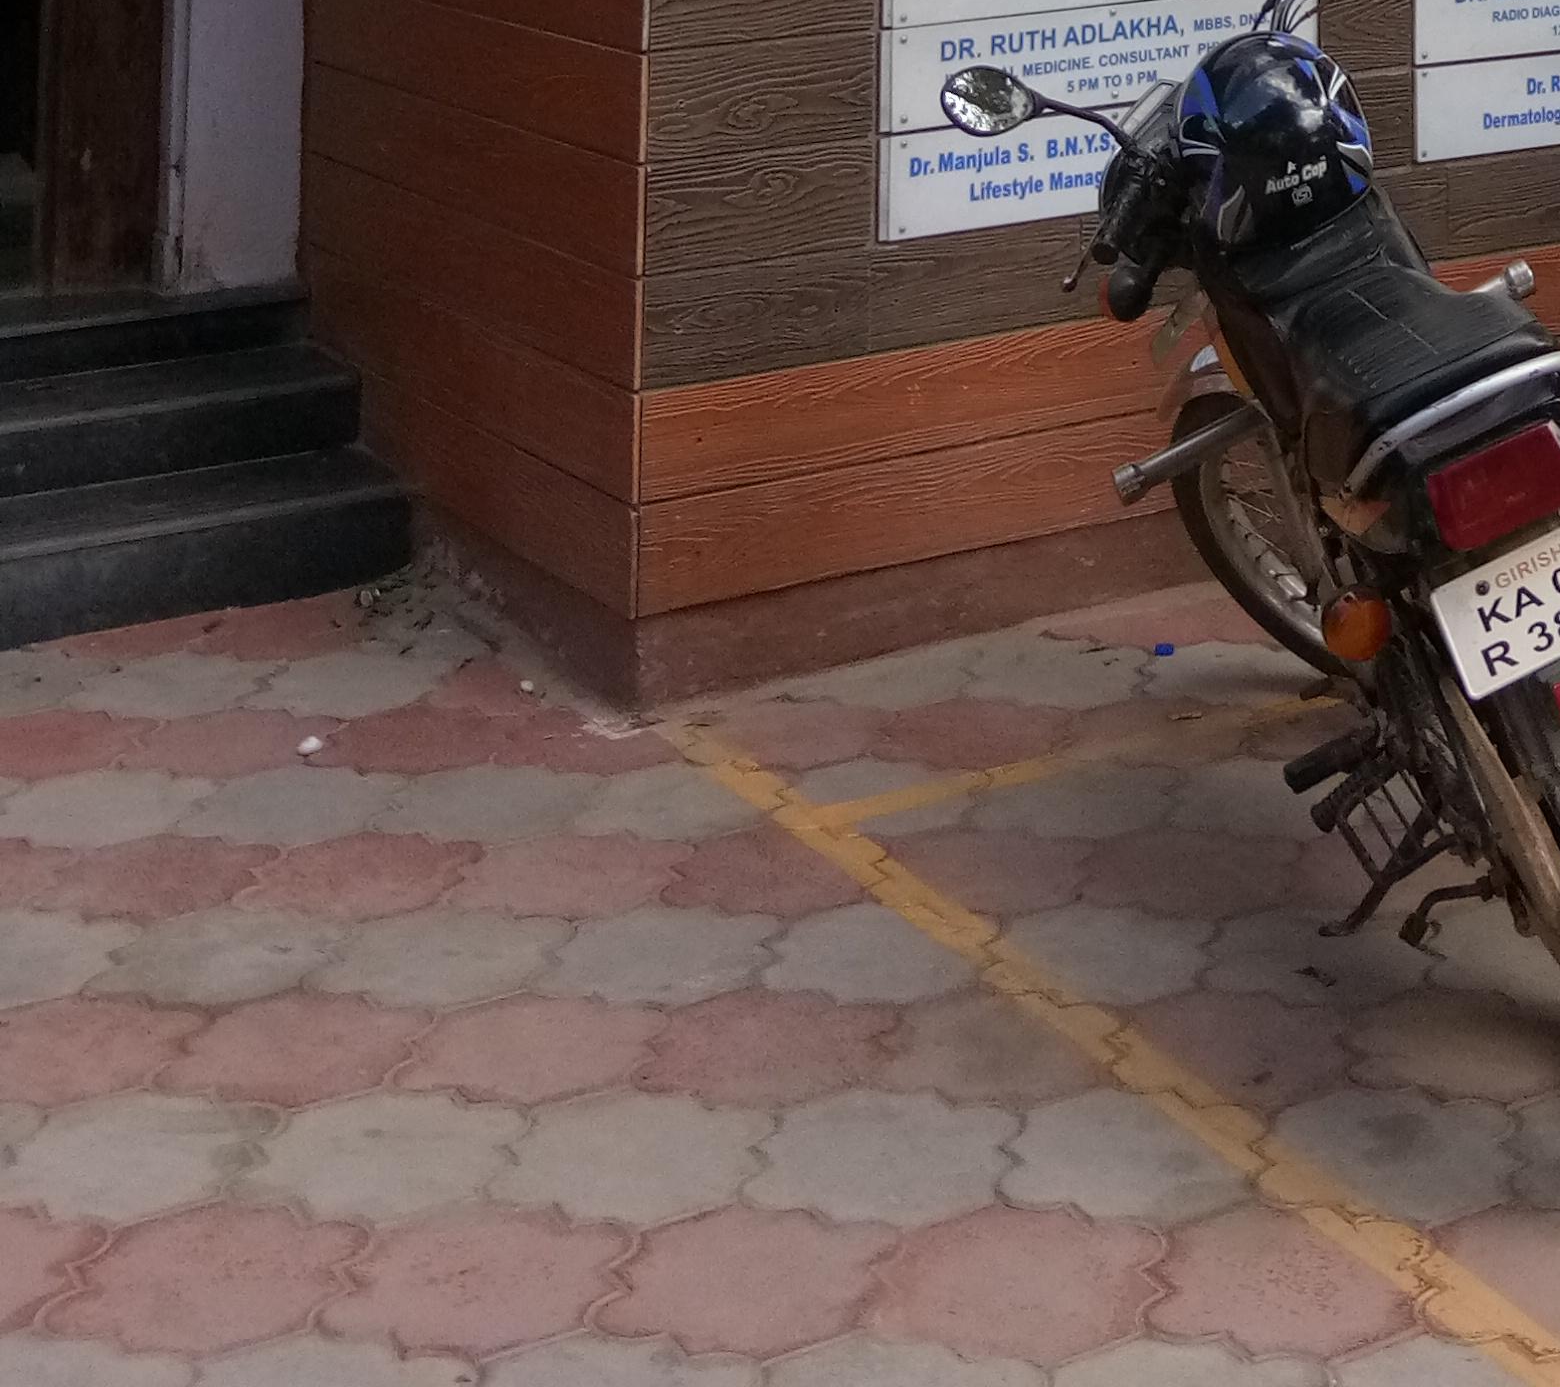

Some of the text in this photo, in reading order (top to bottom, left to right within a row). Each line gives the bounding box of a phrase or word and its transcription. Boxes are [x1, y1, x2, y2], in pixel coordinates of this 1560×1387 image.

[1492, 7, 1528, 22] RADIO
[941, 39, 982, 61] DR.
[990, 29, 1056, 56] RUTH
[1063, 15, 1185, 47] ADLAKHA,
[1193, 16, 1236, 33] MBBS,
[1099, 45, 1189, 67] CONSULTANT
[1067, 70, 1158, 93] 5 PM TO 9 PM
[1527, 78, 1546, 95] Dr.
[910, 143, 1034, 177] Dr. Manjula S.
[970, 171, 1103, 201] Lifestyle Manag
[1477, 587, 1543, 633] KA
[1481, 640, 1519, 677] R
